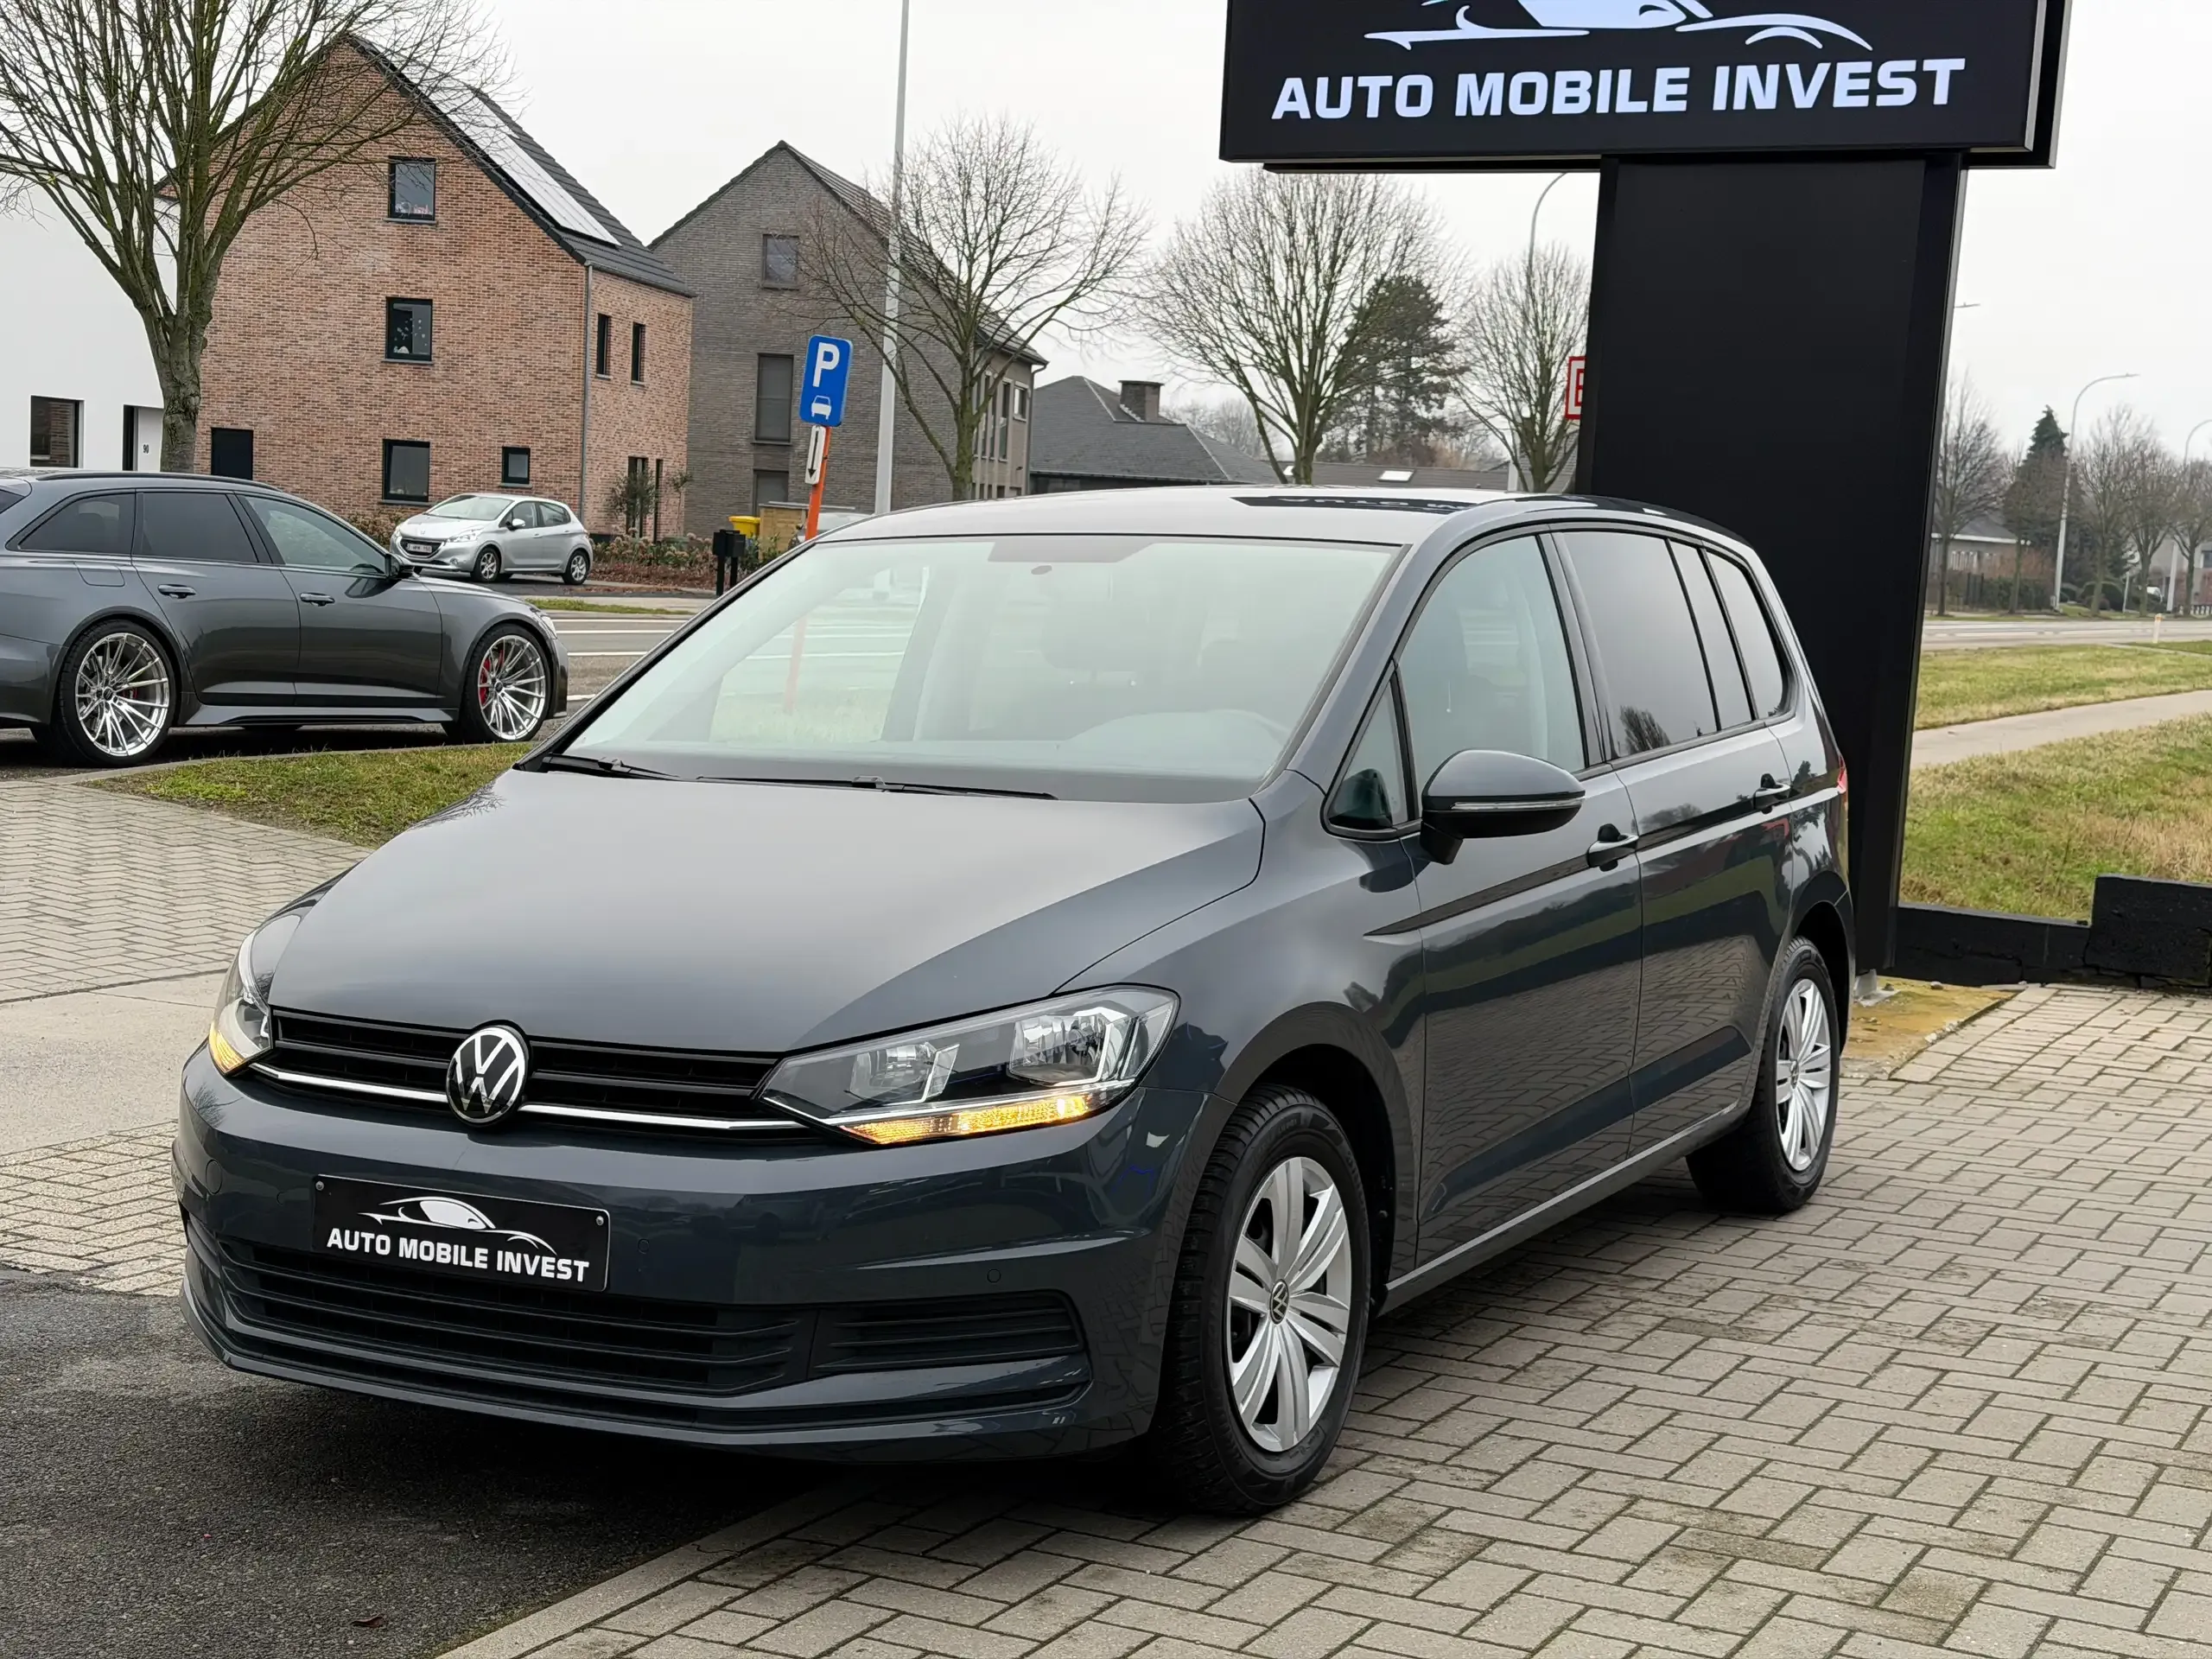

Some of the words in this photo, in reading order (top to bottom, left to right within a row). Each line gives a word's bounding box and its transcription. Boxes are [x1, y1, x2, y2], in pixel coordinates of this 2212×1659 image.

[1271, 74, 1433, 120] AUTO
[1454, 67, 1690, 118] MOBILE
[1713, 58, 1966, 111] INVEST
[812, 342, 840, 387] P
[327, 1228, 391, 1255] AUTO
[398, 1237, 489, 1269] MOBILE
[496, 1249, 590, 1282] INVEST
